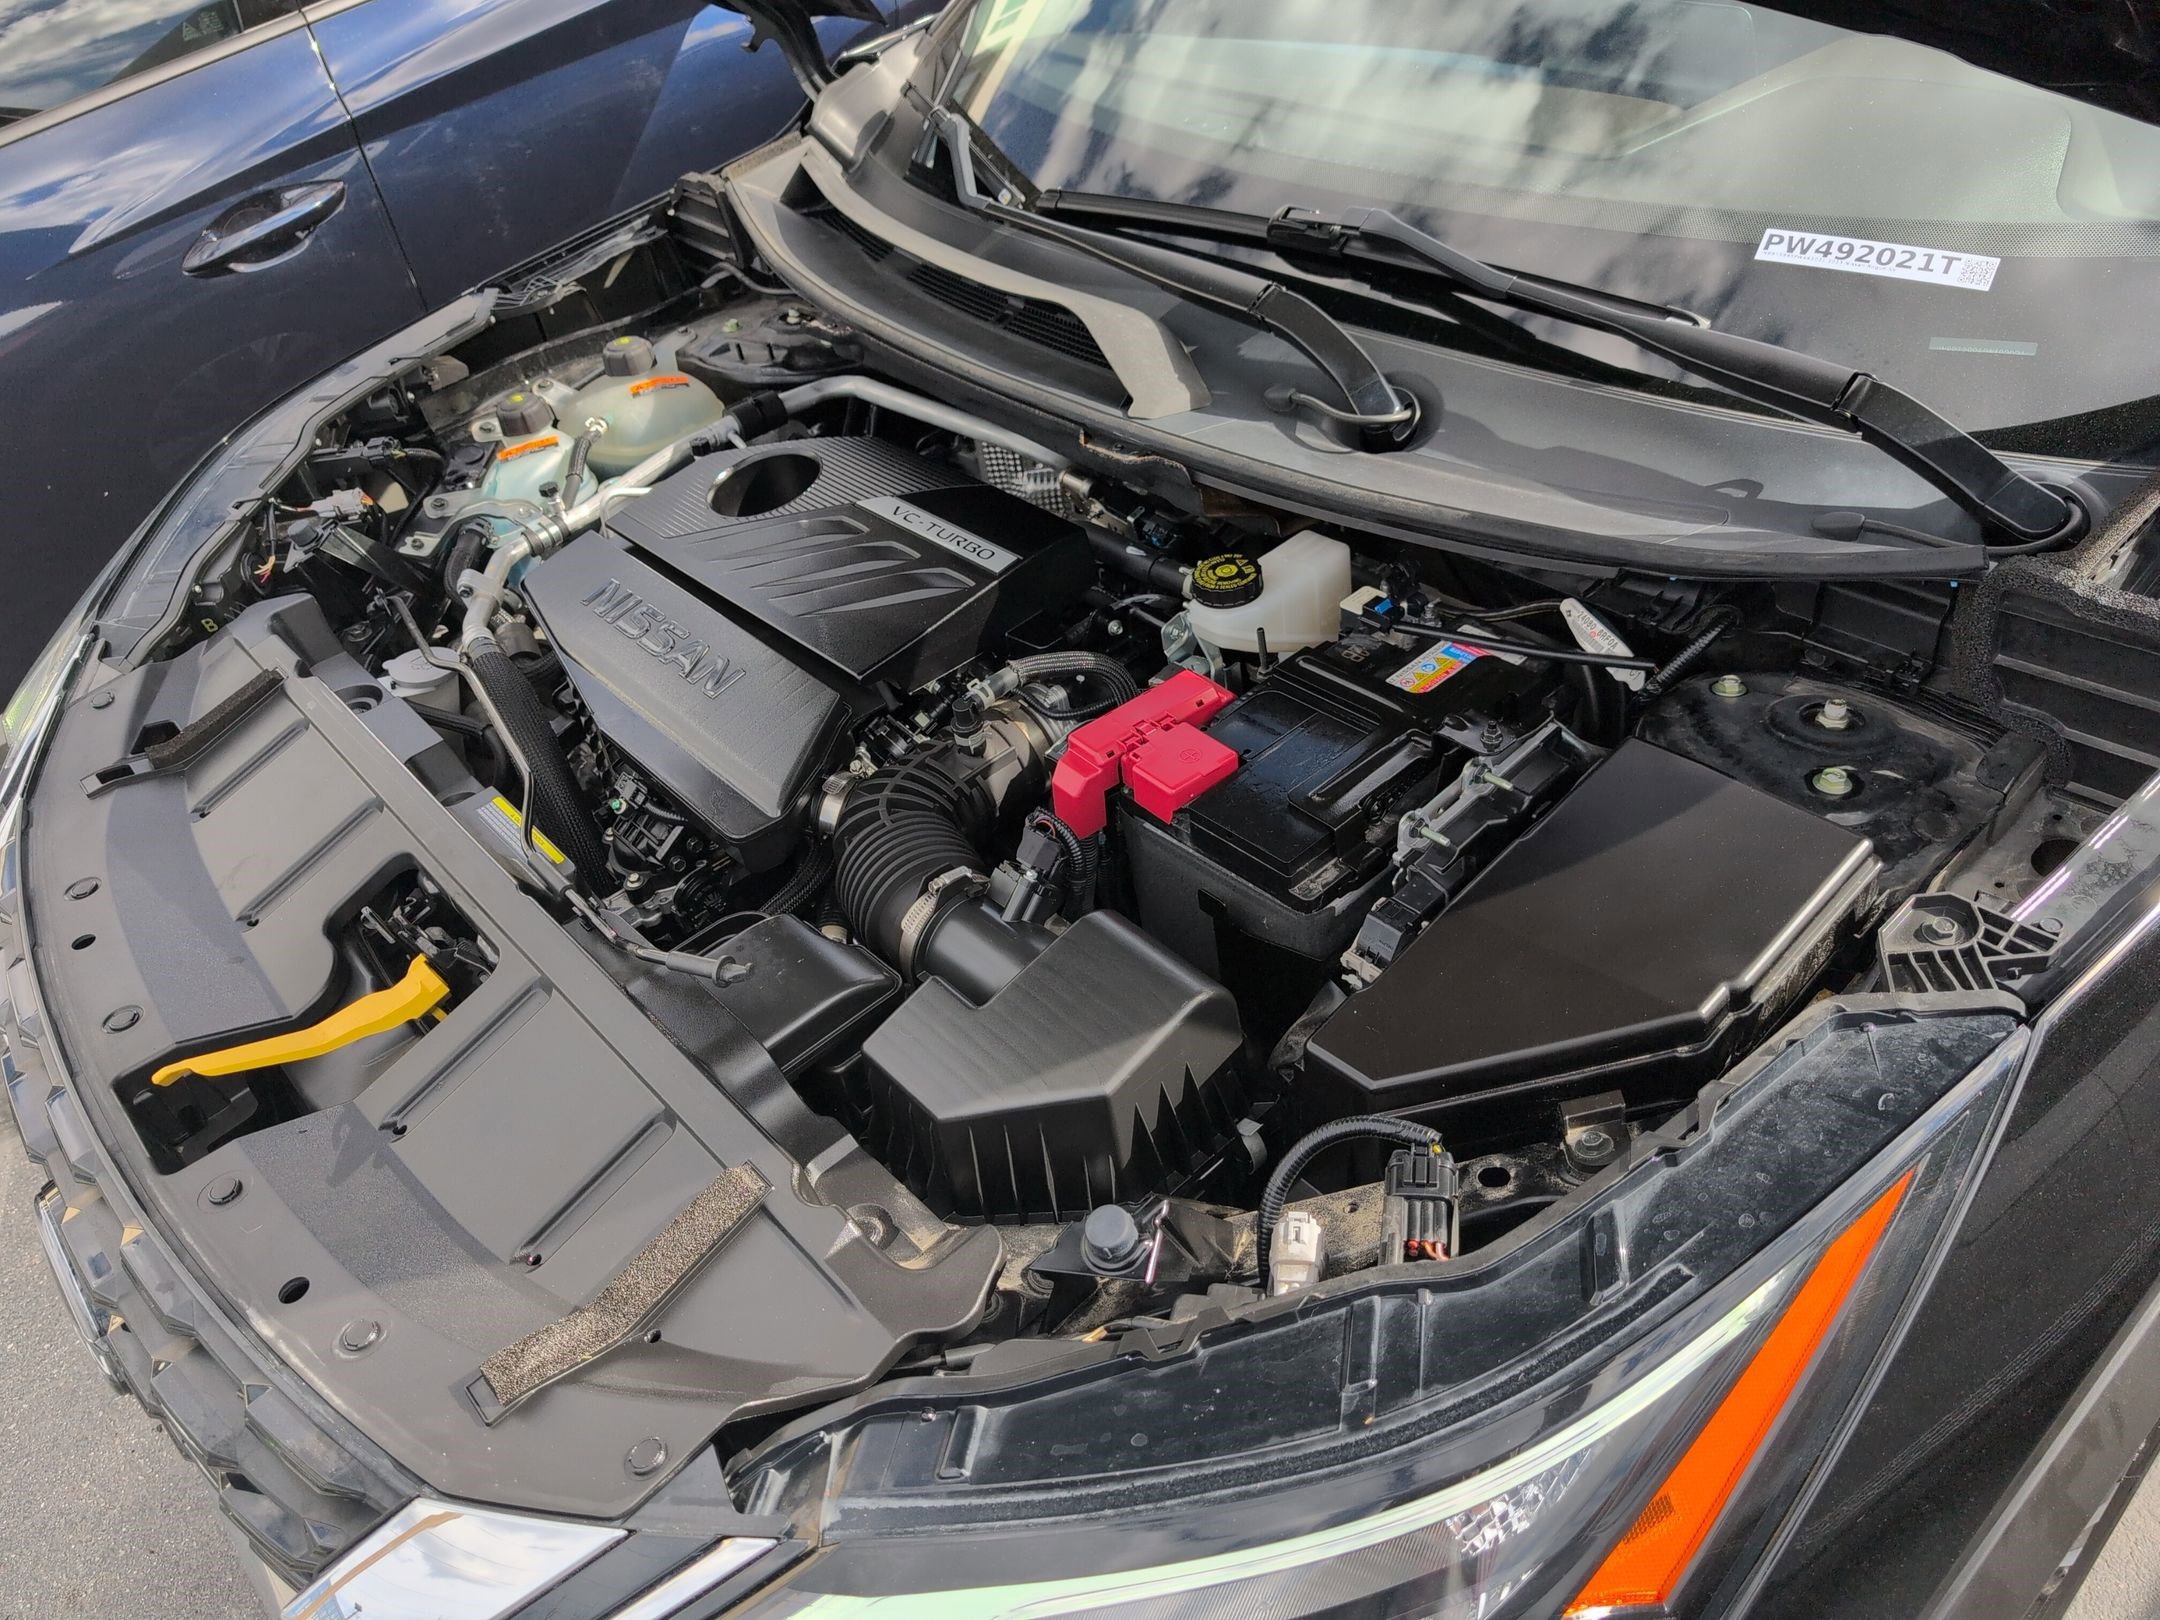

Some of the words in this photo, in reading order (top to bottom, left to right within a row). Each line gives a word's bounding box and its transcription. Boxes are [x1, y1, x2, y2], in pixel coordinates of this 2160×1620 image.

[1763, 233, 1962, 274] PW492021T
[892, 505, 996, 560] VC-TURBO
[580, 578, 747, 700] NISSAN
